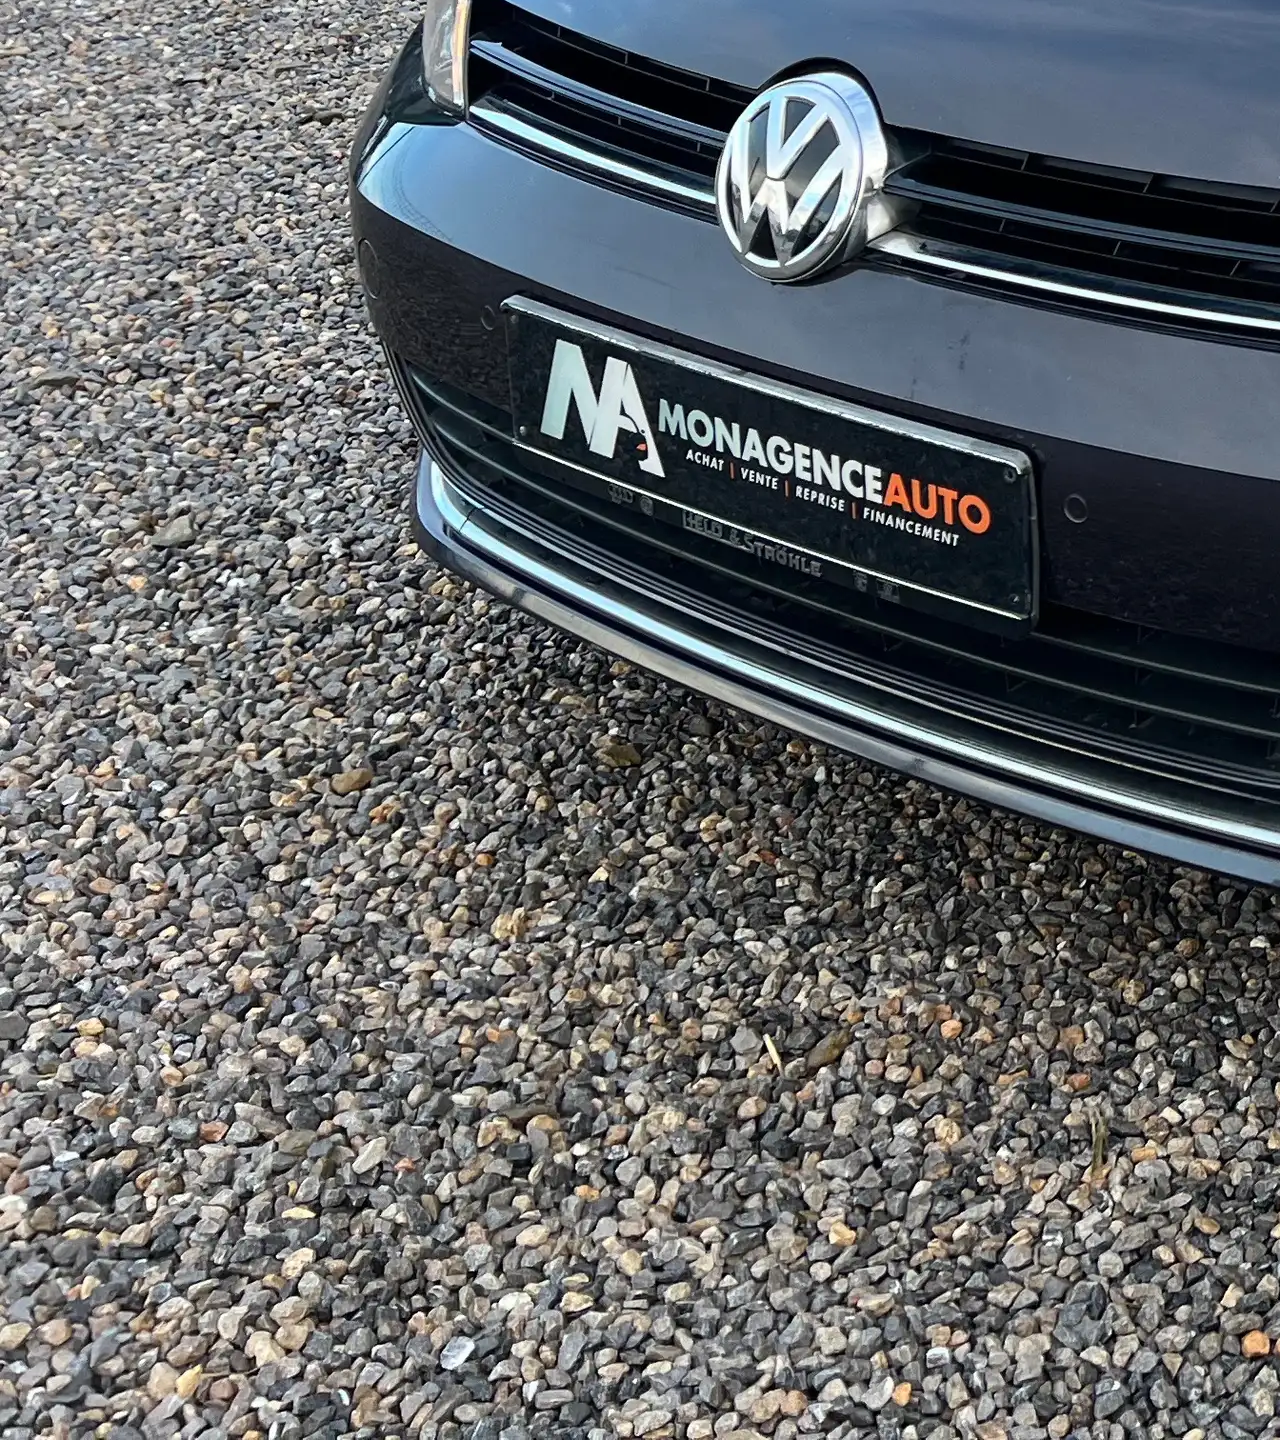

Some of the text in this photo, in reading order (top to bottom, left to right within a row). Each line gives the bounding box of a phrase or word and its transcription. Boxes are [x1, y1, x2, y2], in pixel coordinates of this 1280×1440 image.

[658, 398, 991, 534] MONAGENCEAUTO
[685, 449, 960, 547] ACHAT VENTE REPRISE FINANCEMENT
